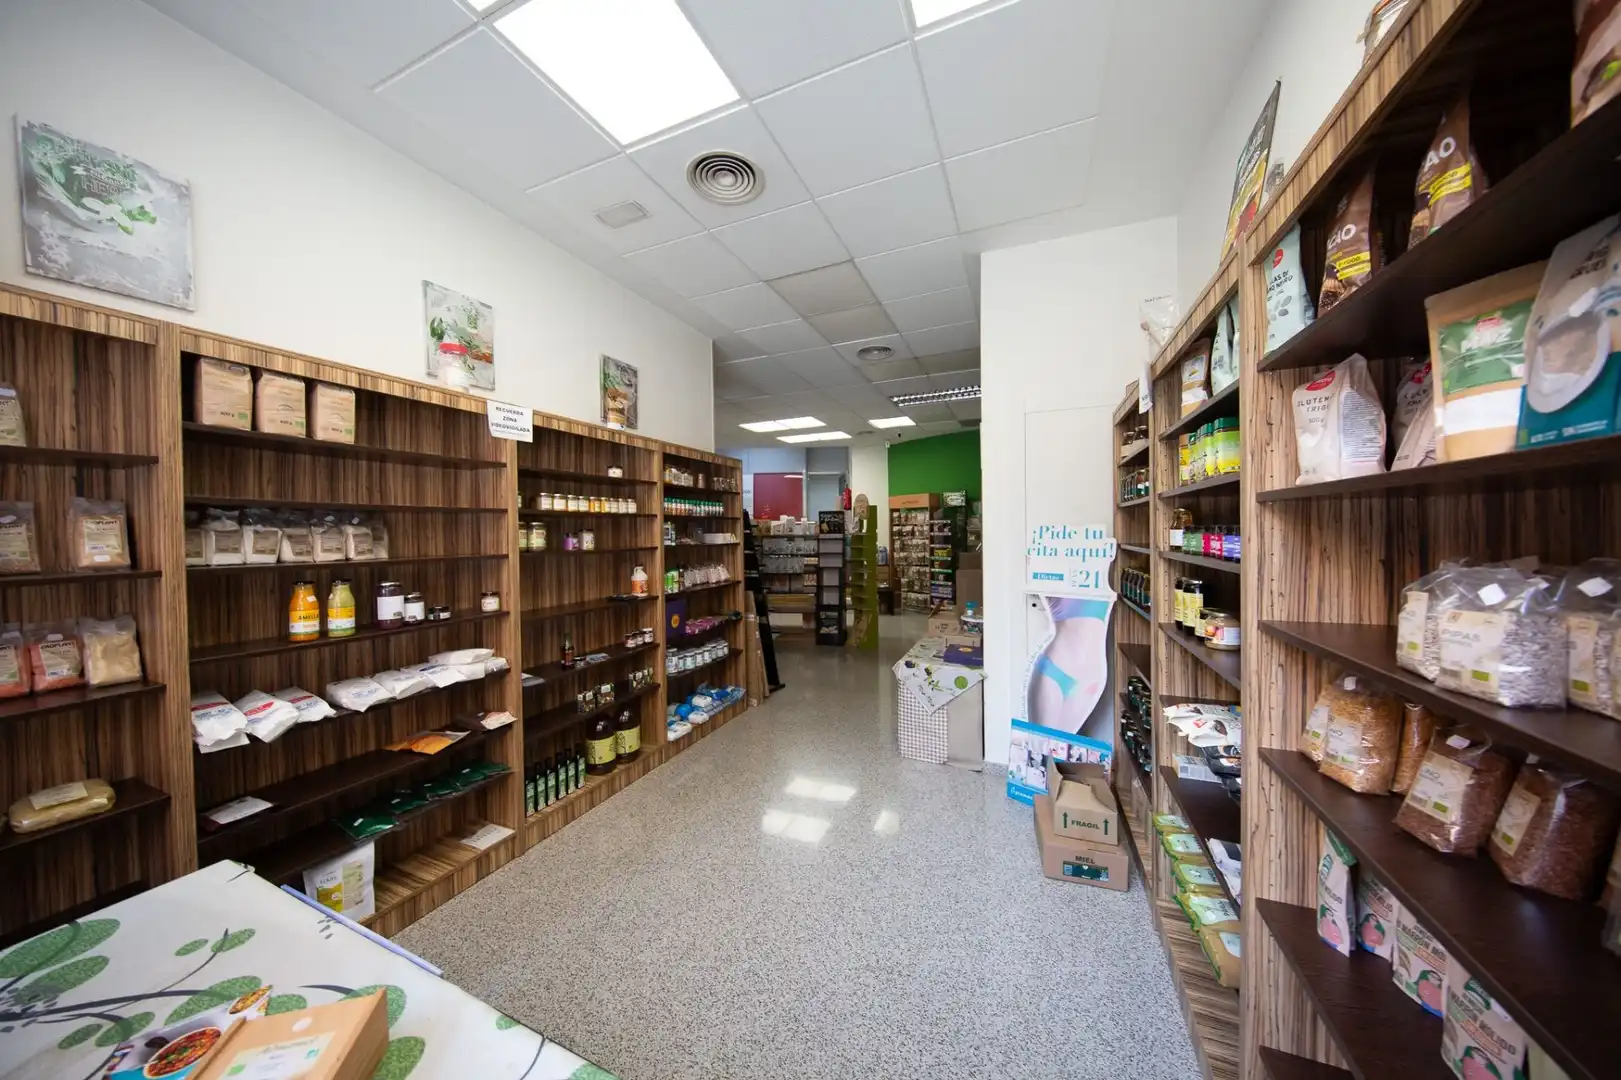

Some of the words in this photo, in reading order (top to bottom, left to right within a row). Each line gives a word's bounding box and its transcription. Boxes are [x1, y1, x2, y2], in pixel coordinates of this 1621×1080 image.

[495, 406, 524, 416] RECUERDA
[491, 422, 530, 433] VIDEOVIGILADA
[1032, 524, 1077, 544] ¡Pide
[1085, 527, 1103, 539] tu
[1027, 542, 1058, 556] cita
[1065, 542, 1113, 563] aquí!
[1078, 570, 1099, 589] 21
[1071, 819, 1100, 830] FRAGIL
[1075, 855, 1096, 865] MIEL
